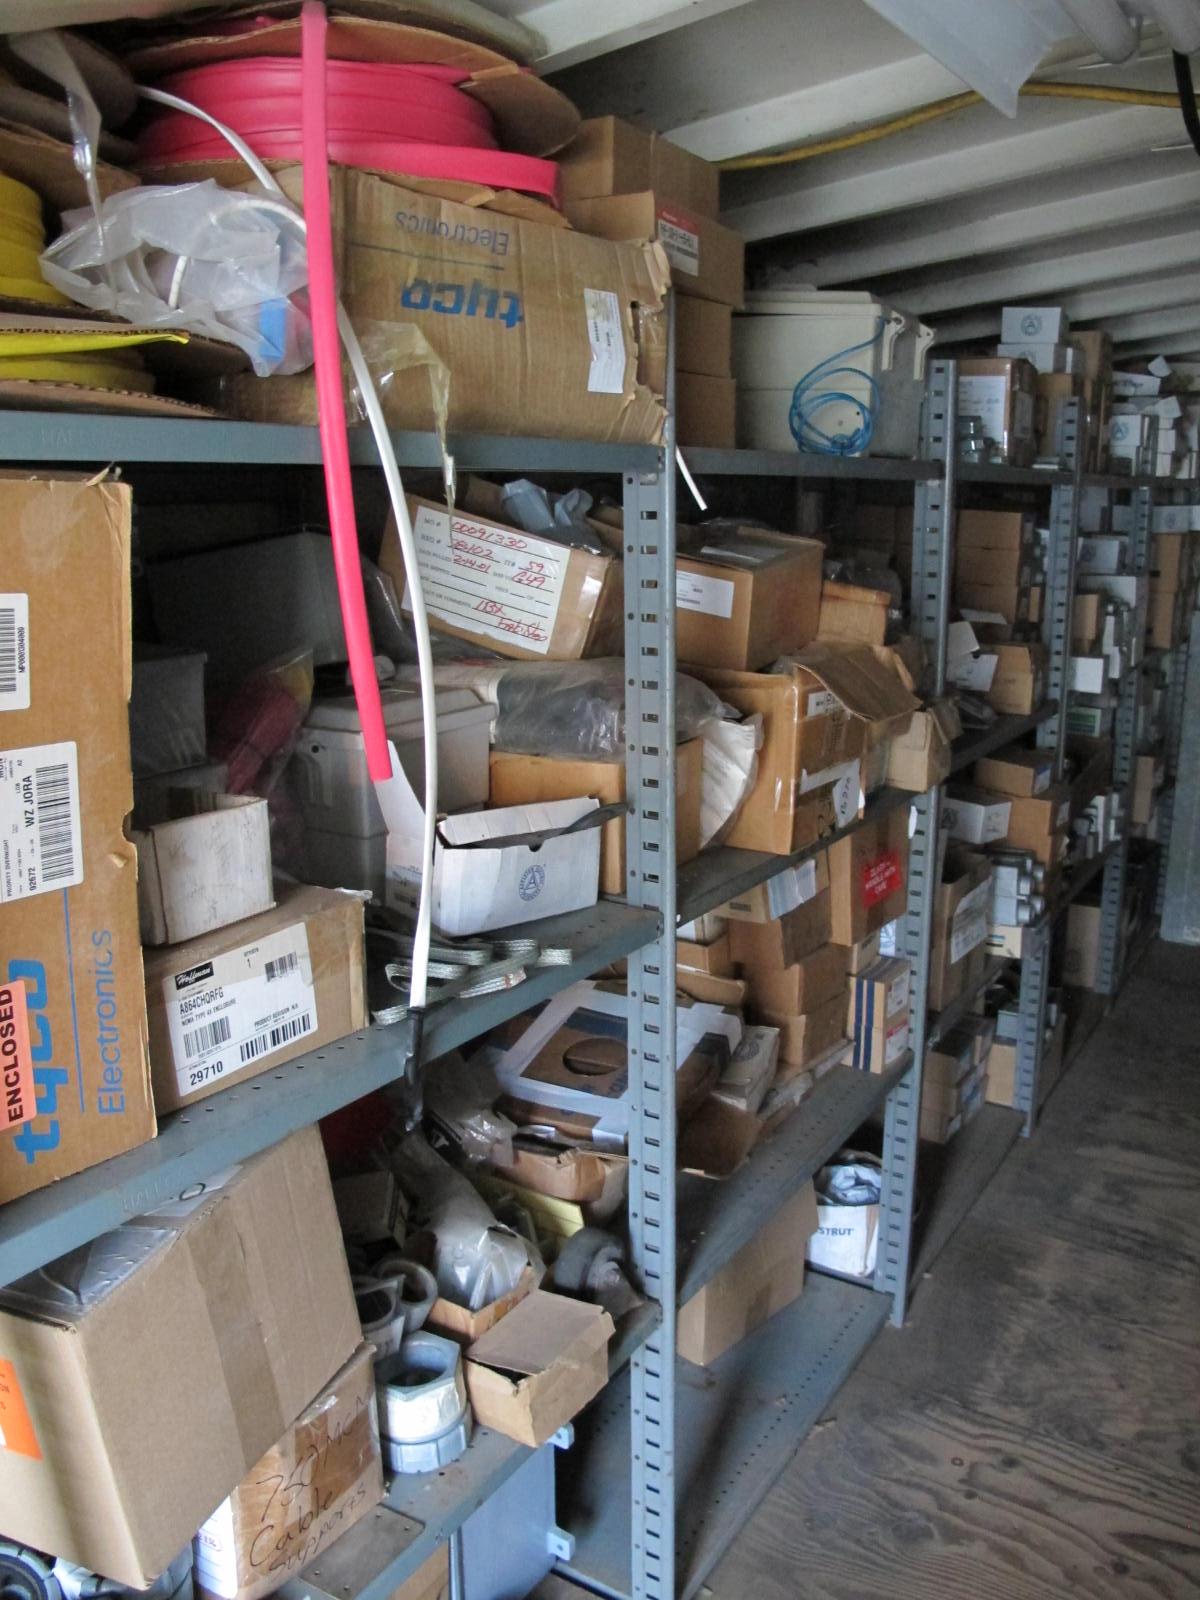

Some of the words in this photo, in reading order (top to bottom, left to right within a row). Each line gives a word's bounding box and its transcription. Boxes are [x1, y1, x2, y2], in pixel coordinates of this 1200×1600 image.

[401, 278, 525, 328] tyco
[22, 775, 34, 805] JORA
[24, 808, 35, 828] WZ
[92, 929, 126, 1115] Electronics
[0, 988, 24, 1123] ENCLOSED
[190, 1060, 224, 1087] 29710
[249, 1487, 334, 1567] Cable
